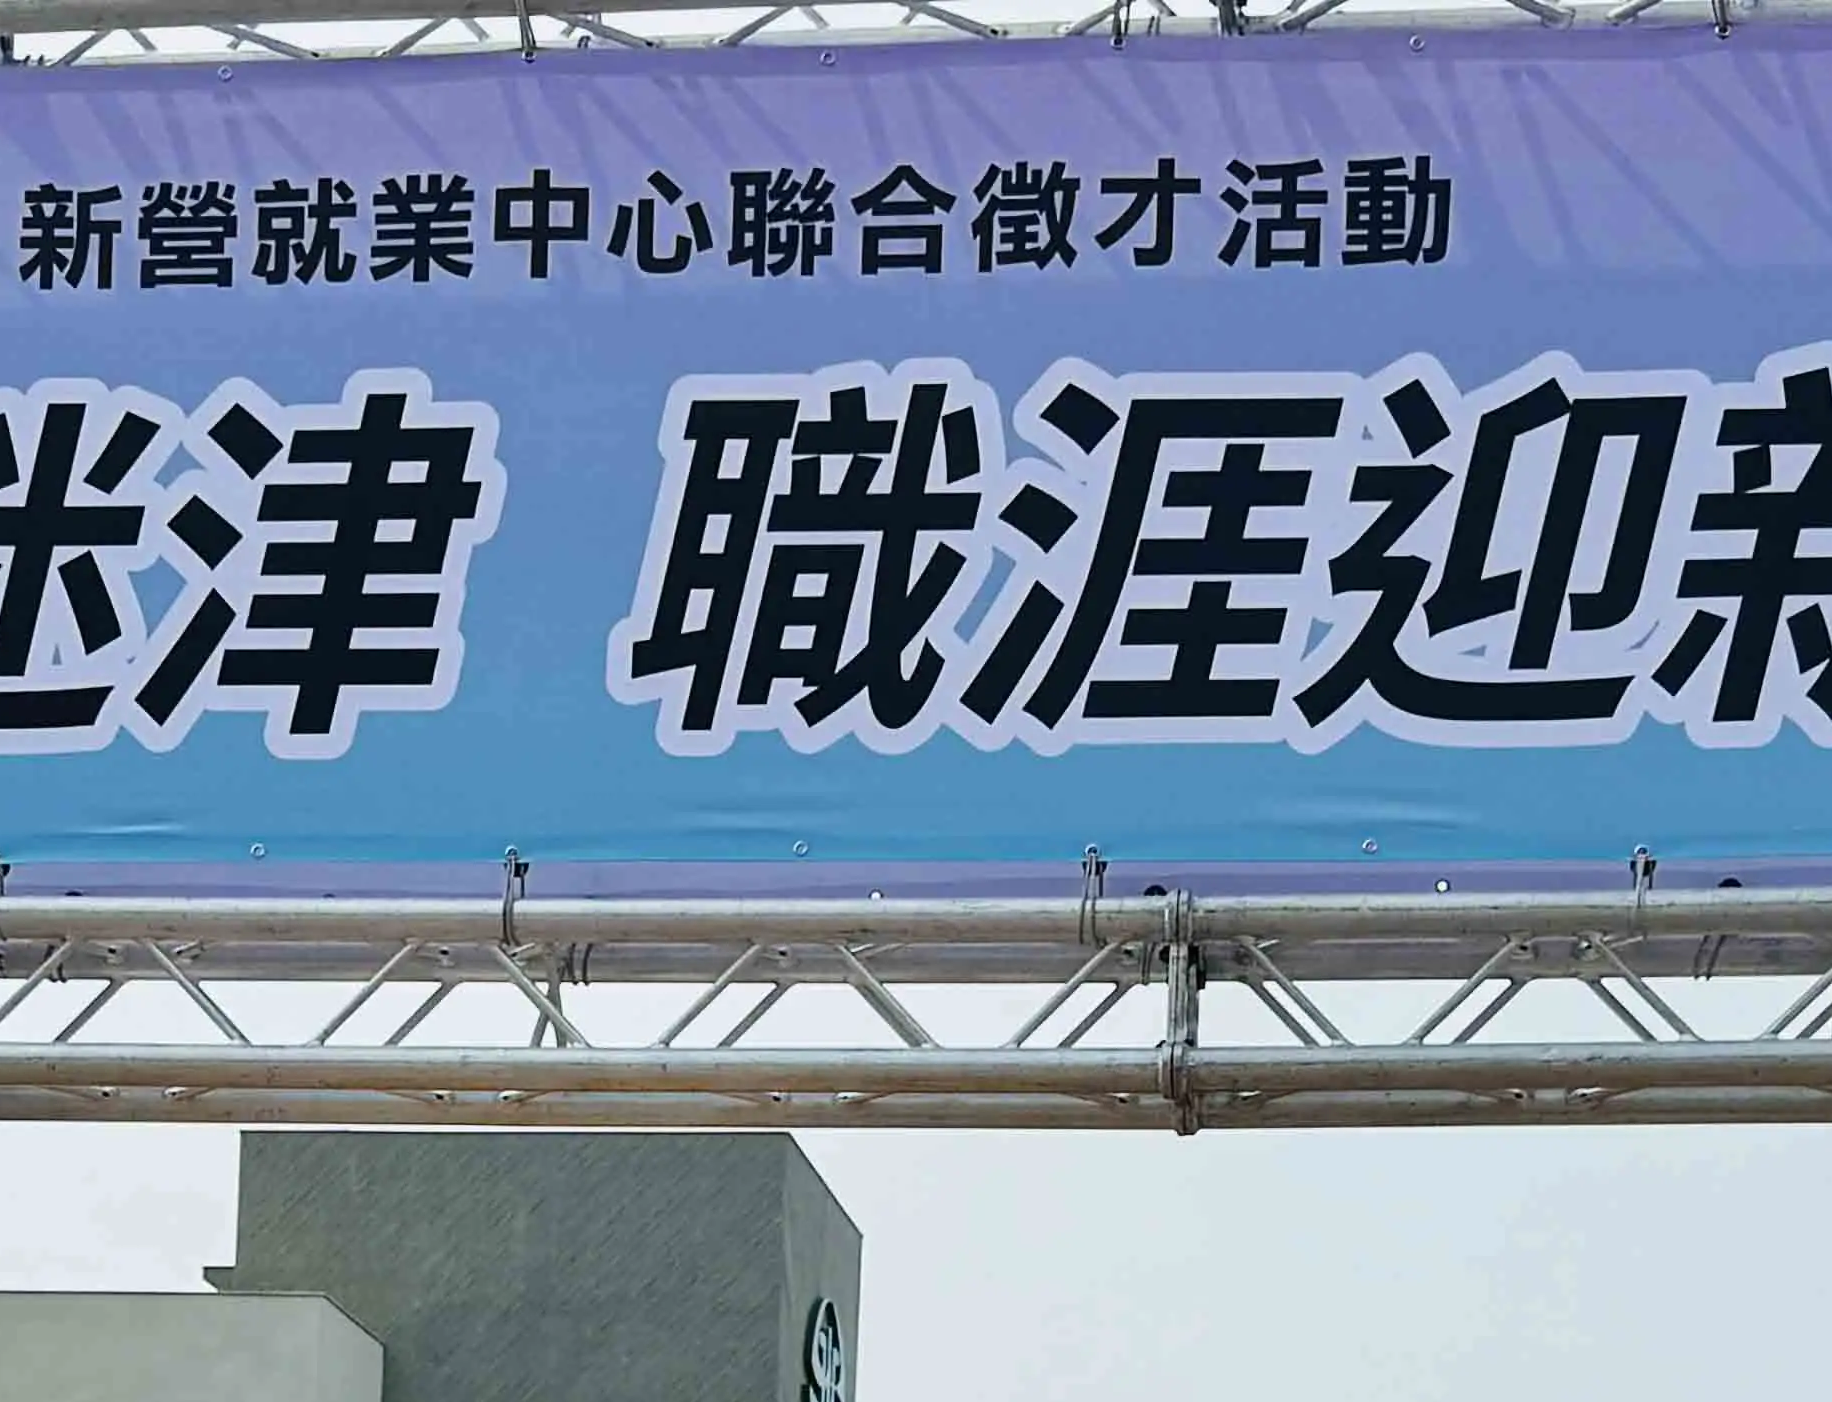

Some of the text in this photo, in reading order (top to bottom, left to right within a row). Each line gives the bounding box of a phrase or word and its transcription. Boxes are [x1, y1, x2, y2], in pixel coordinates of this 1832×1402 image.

[18, 154, 1453, 291] 新營就業中心聯合徵才活動
